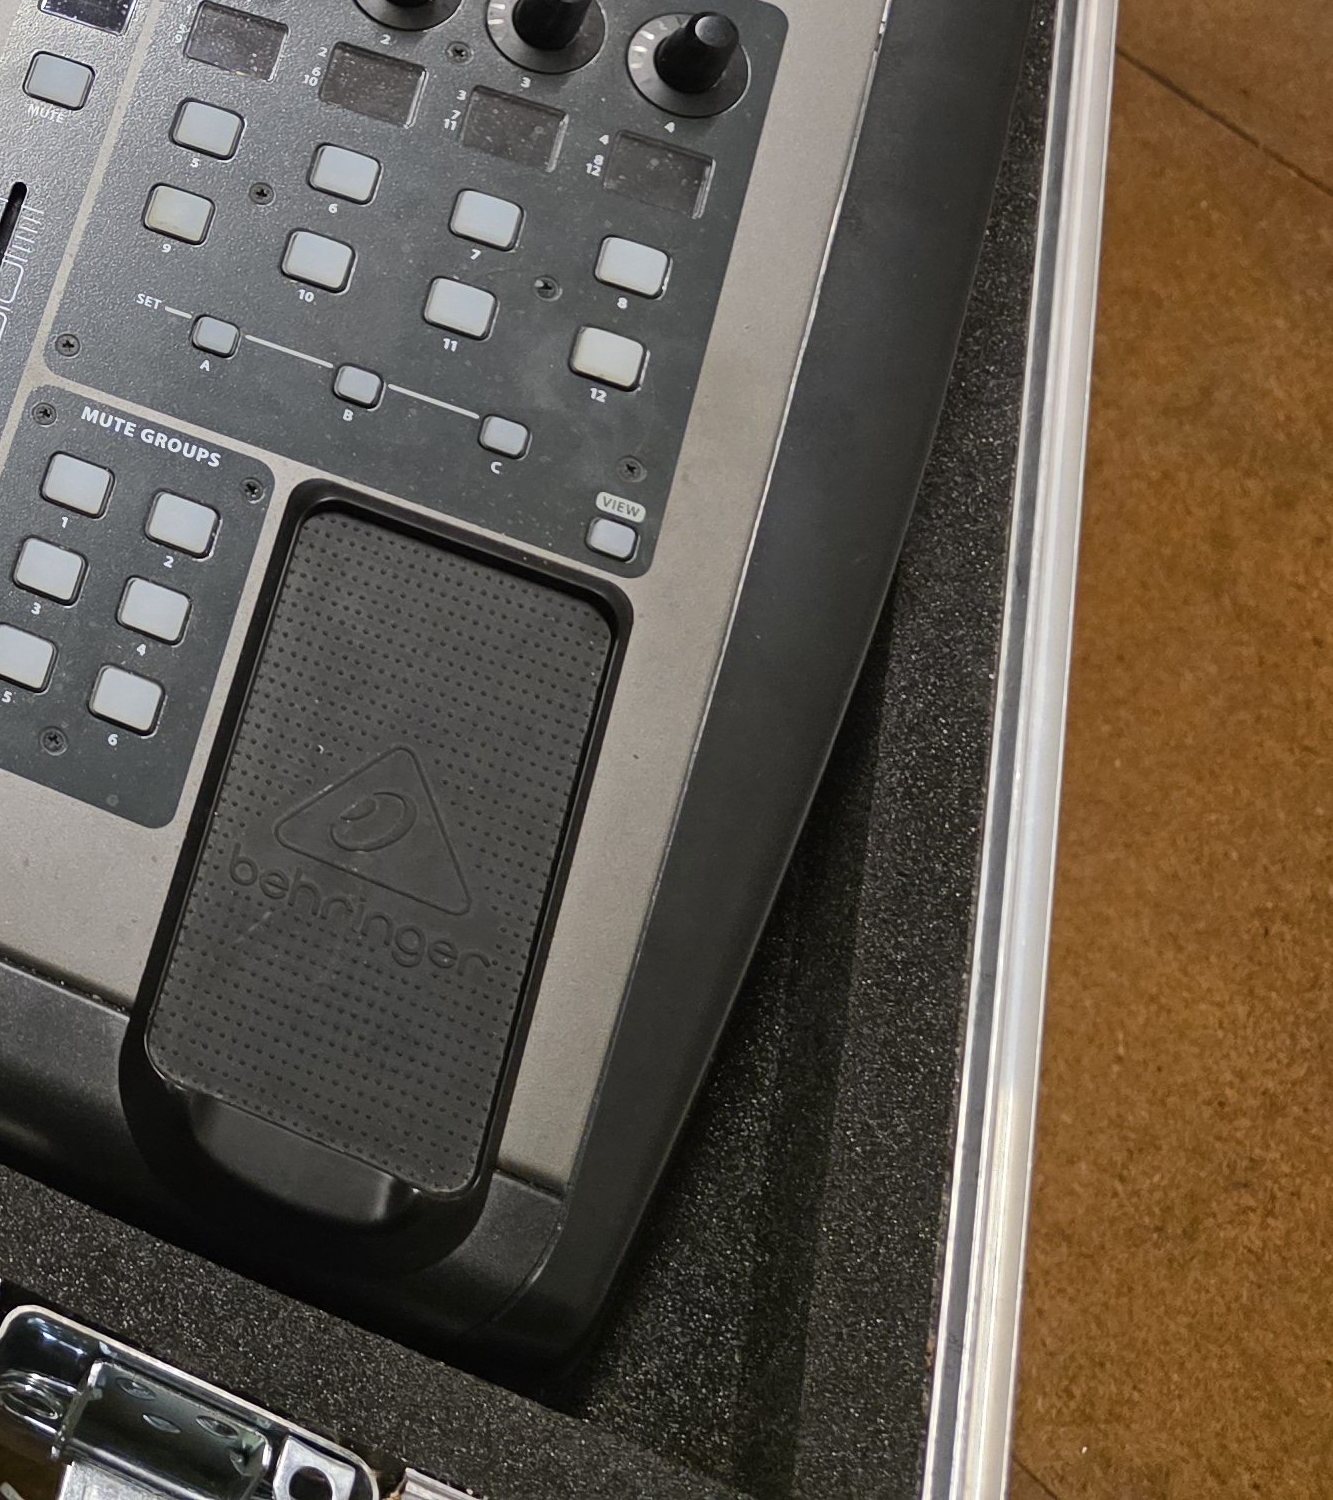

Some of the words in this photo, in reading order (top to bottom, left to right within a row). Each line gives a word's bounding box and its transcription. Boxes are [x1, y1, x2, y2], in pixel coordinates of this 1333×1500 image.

[136, 293, 163, 311] SET
[298, 289, 315, 303] 10
[443, 337, 458, 352] 11
[589, 387, 607, 403] 12
[80, 405, 138, 438] MUTE
[139, 428, 222, 468] GROUPS
[602, 495, 641, 518] VIEW
[228, 842, 491, 976] behringer
